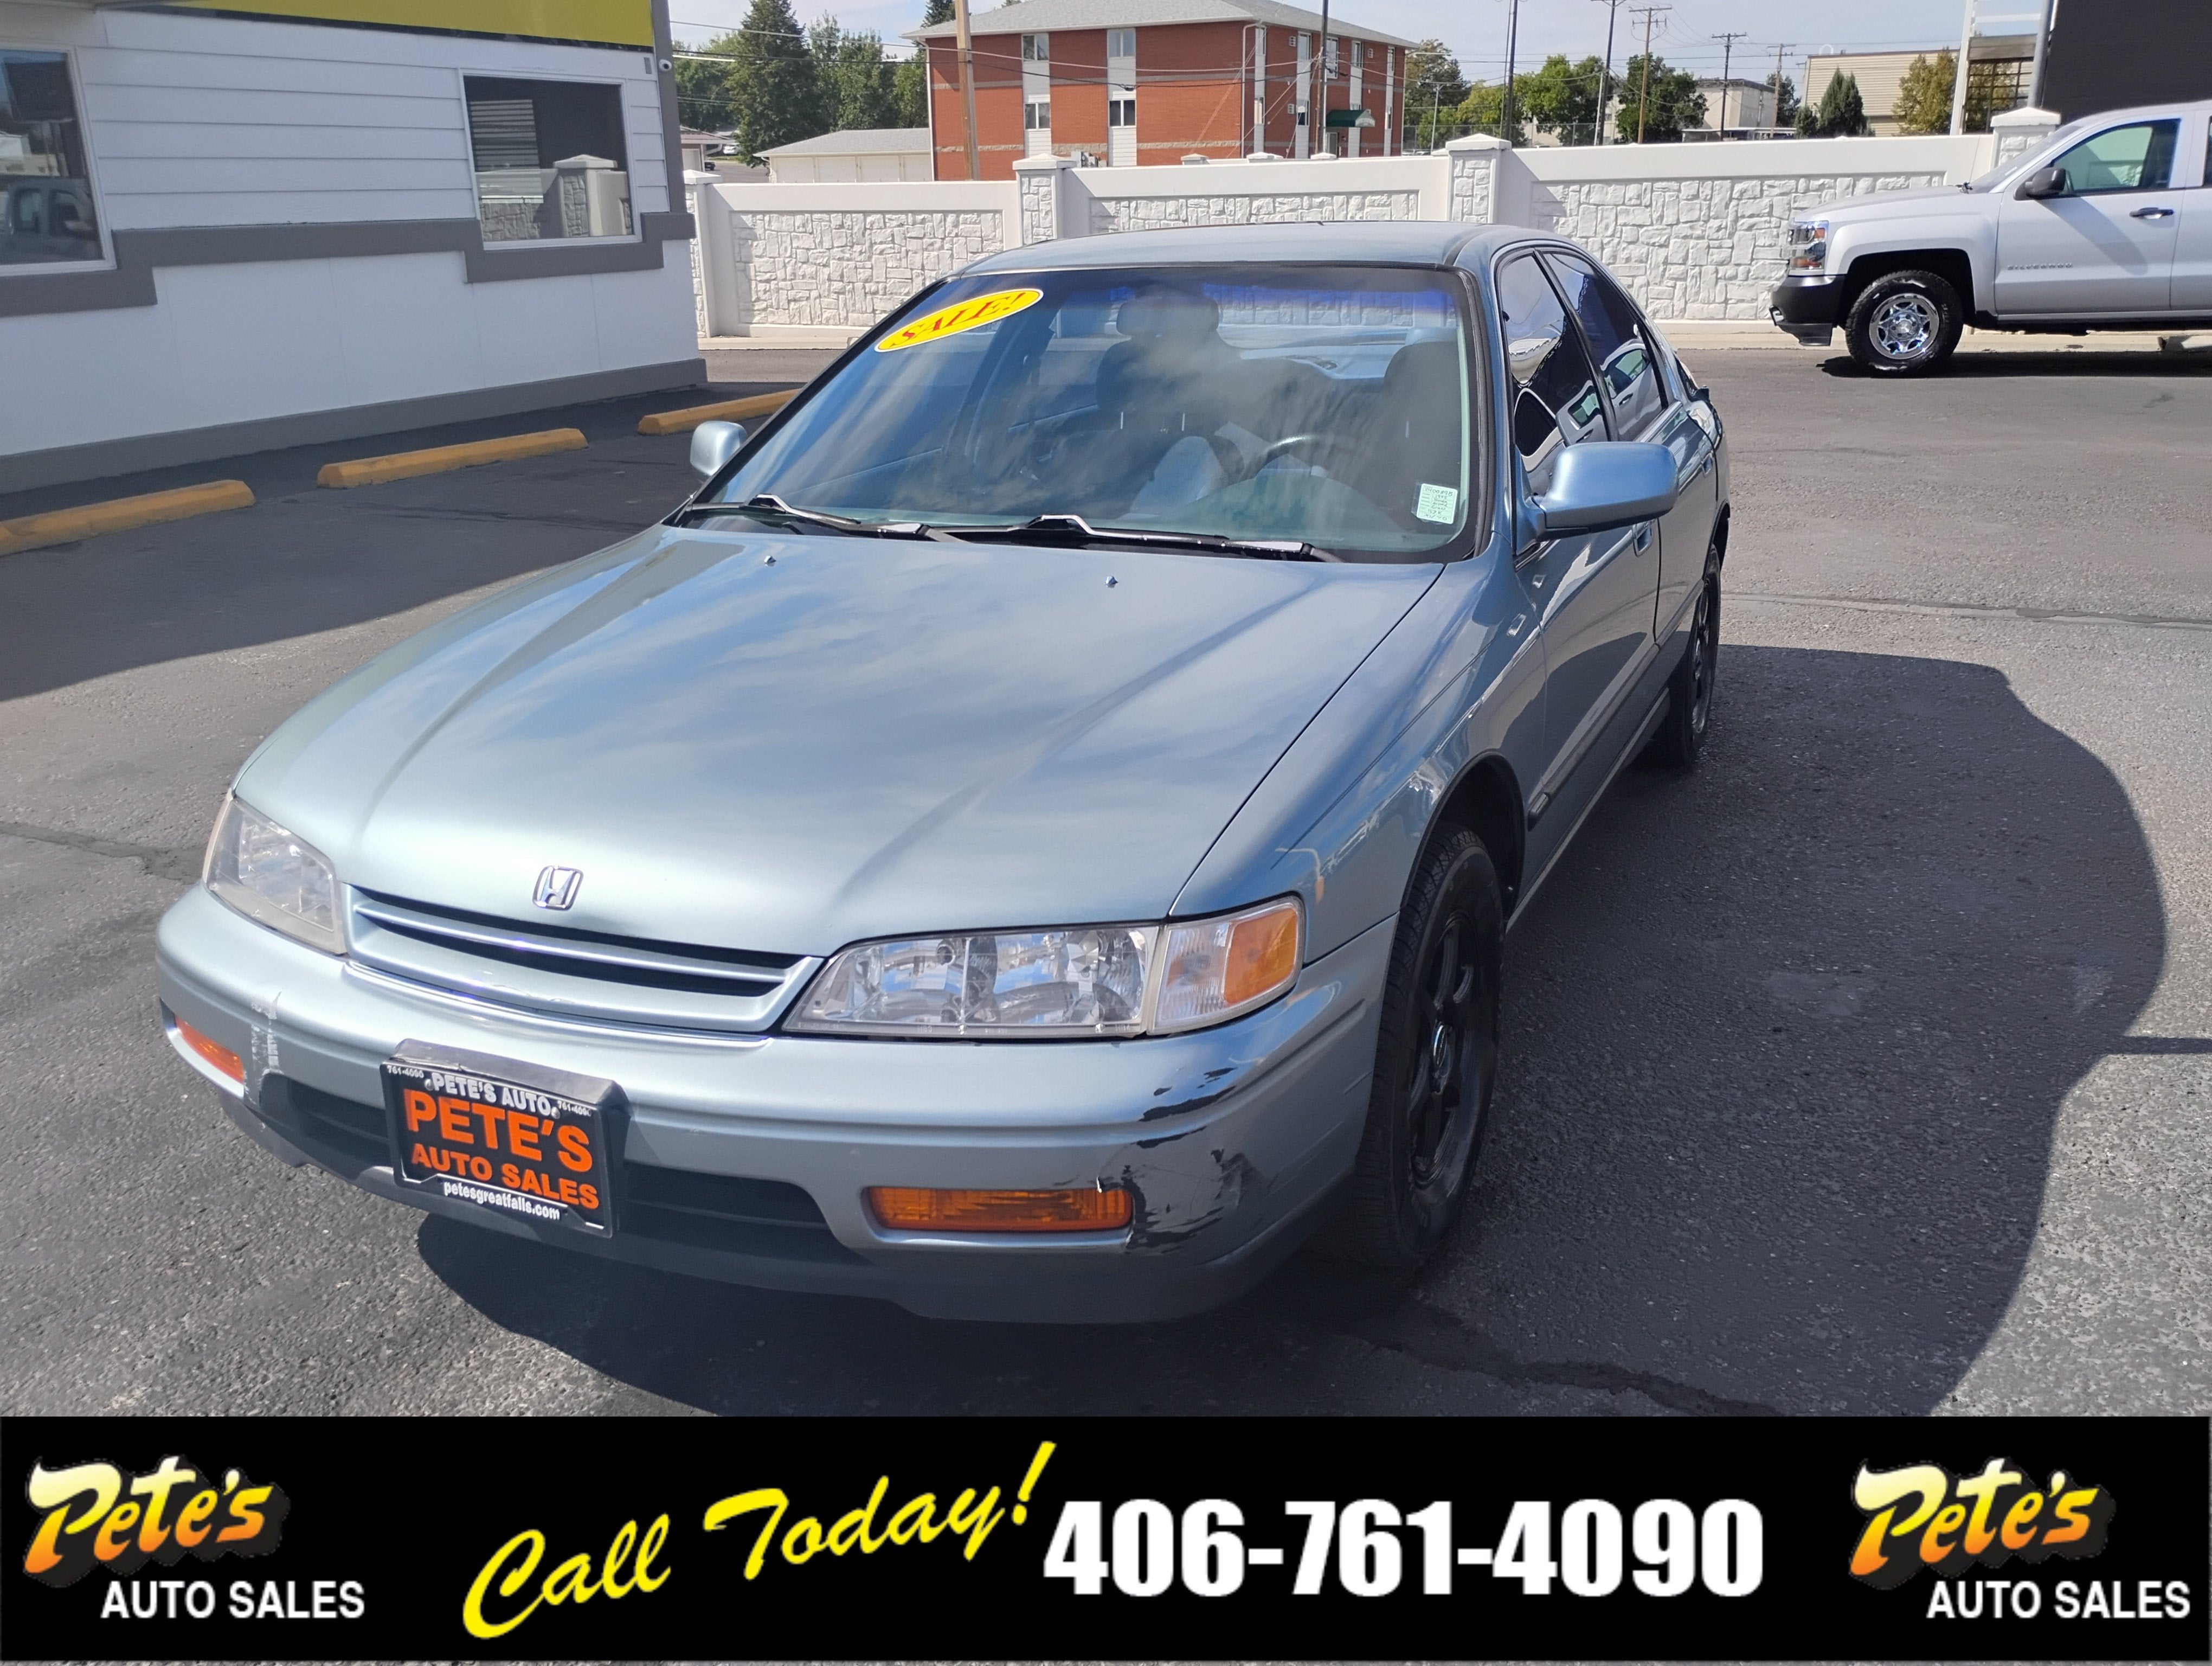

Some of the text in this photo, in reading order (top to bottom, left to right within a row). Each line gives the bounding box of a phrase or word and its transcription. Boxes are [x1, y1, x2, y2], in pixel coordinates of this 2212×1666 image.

[889, 292, 1026, 347] SALE!
[387, 1065, 424, 1079] 761-4090
[431, 1072, 551, 1117] PETE'S AUTO
[403, 1088, 593, 1172] PETE'S
[411, 1143, 600, 1209] AUTO SALES
[443, 1181, 560, 1220] petesgreatfalls.com
